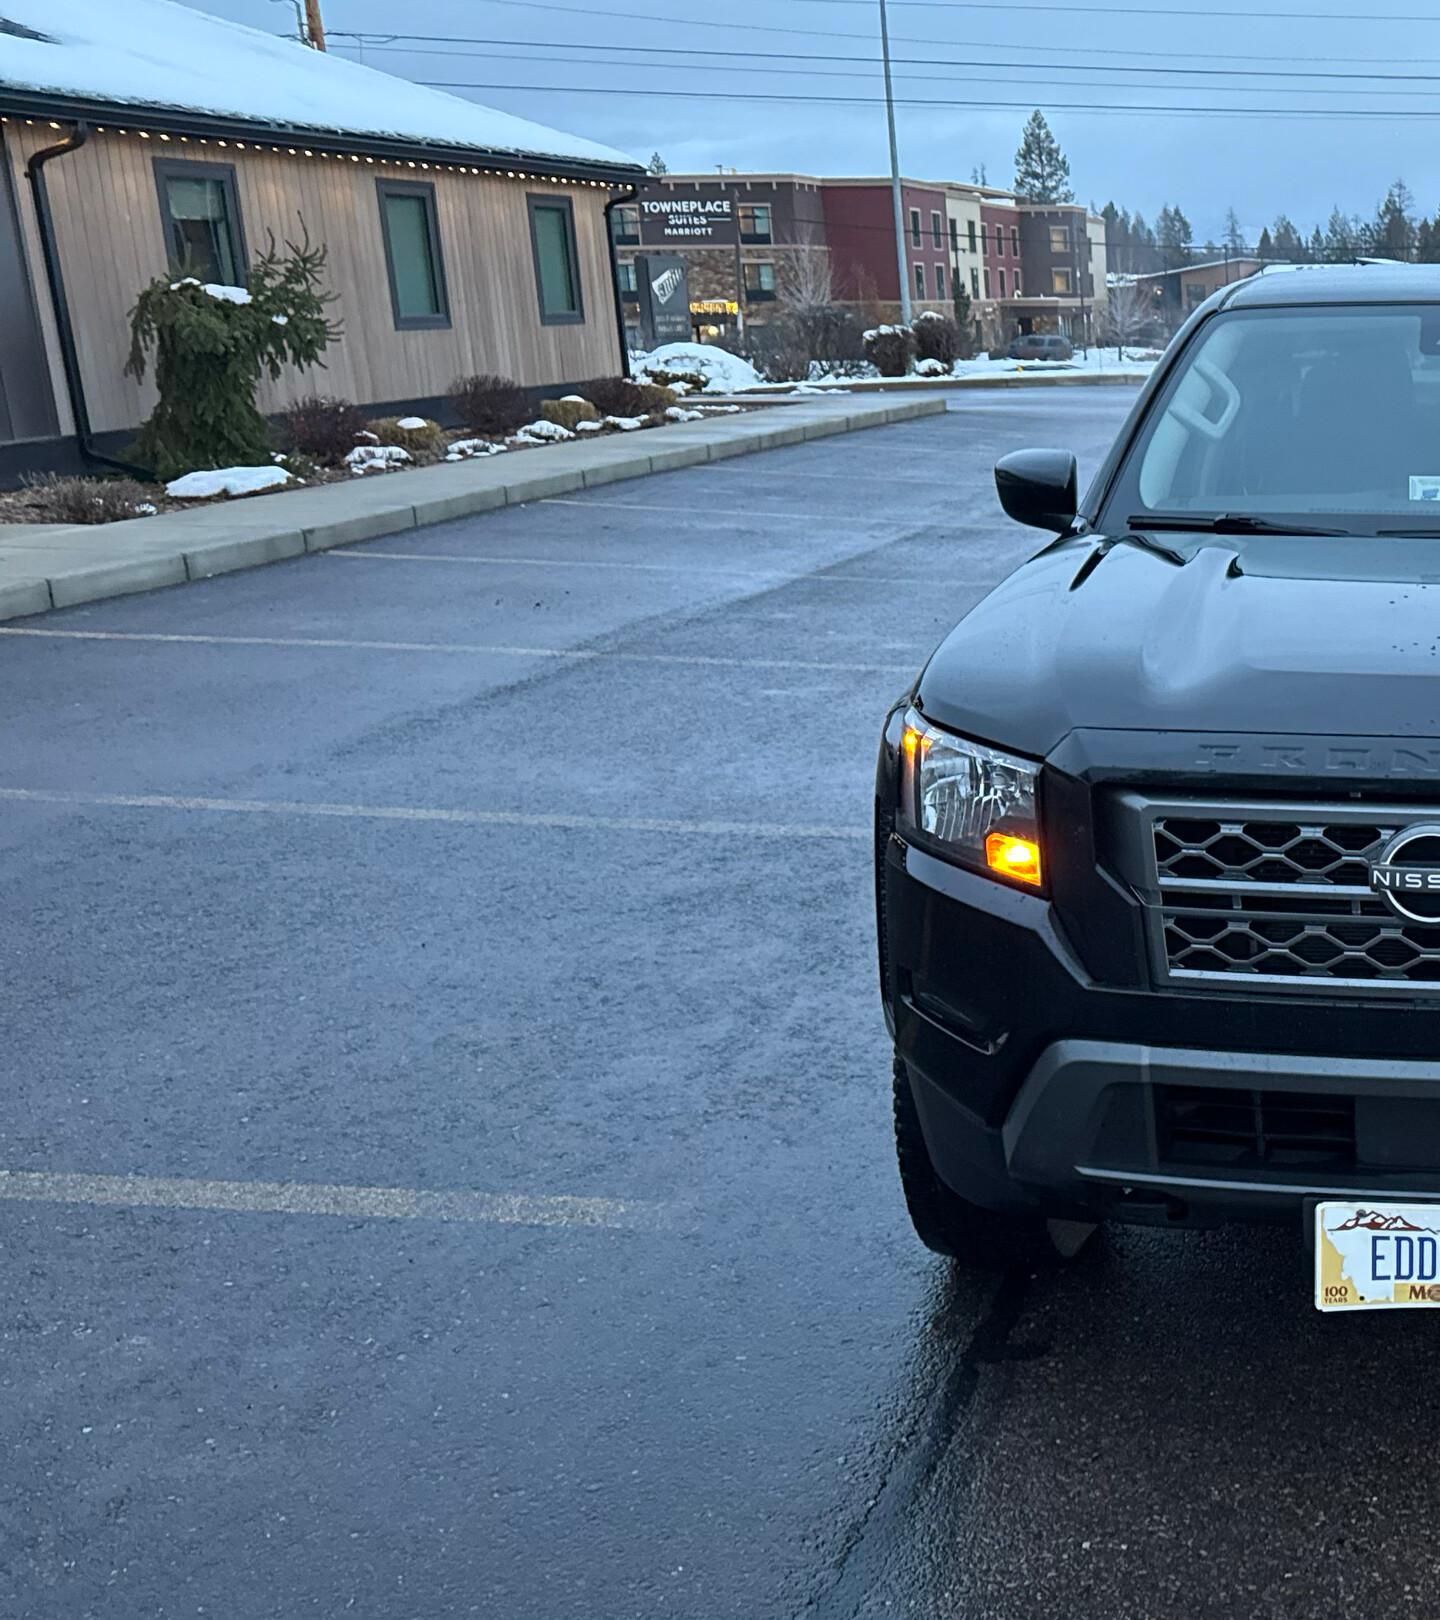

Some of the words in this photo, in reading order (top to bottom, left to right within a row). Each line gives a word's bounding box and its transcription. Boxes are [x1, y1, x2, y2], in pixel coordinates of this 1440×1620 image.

[641, 201, 731, 213] TOWNEPLACE
[668, 214, 708, 225] SUITES
[664, 228, 713, 236] MARRIOTT
[1324, 1286, 1348, 1297] 100
